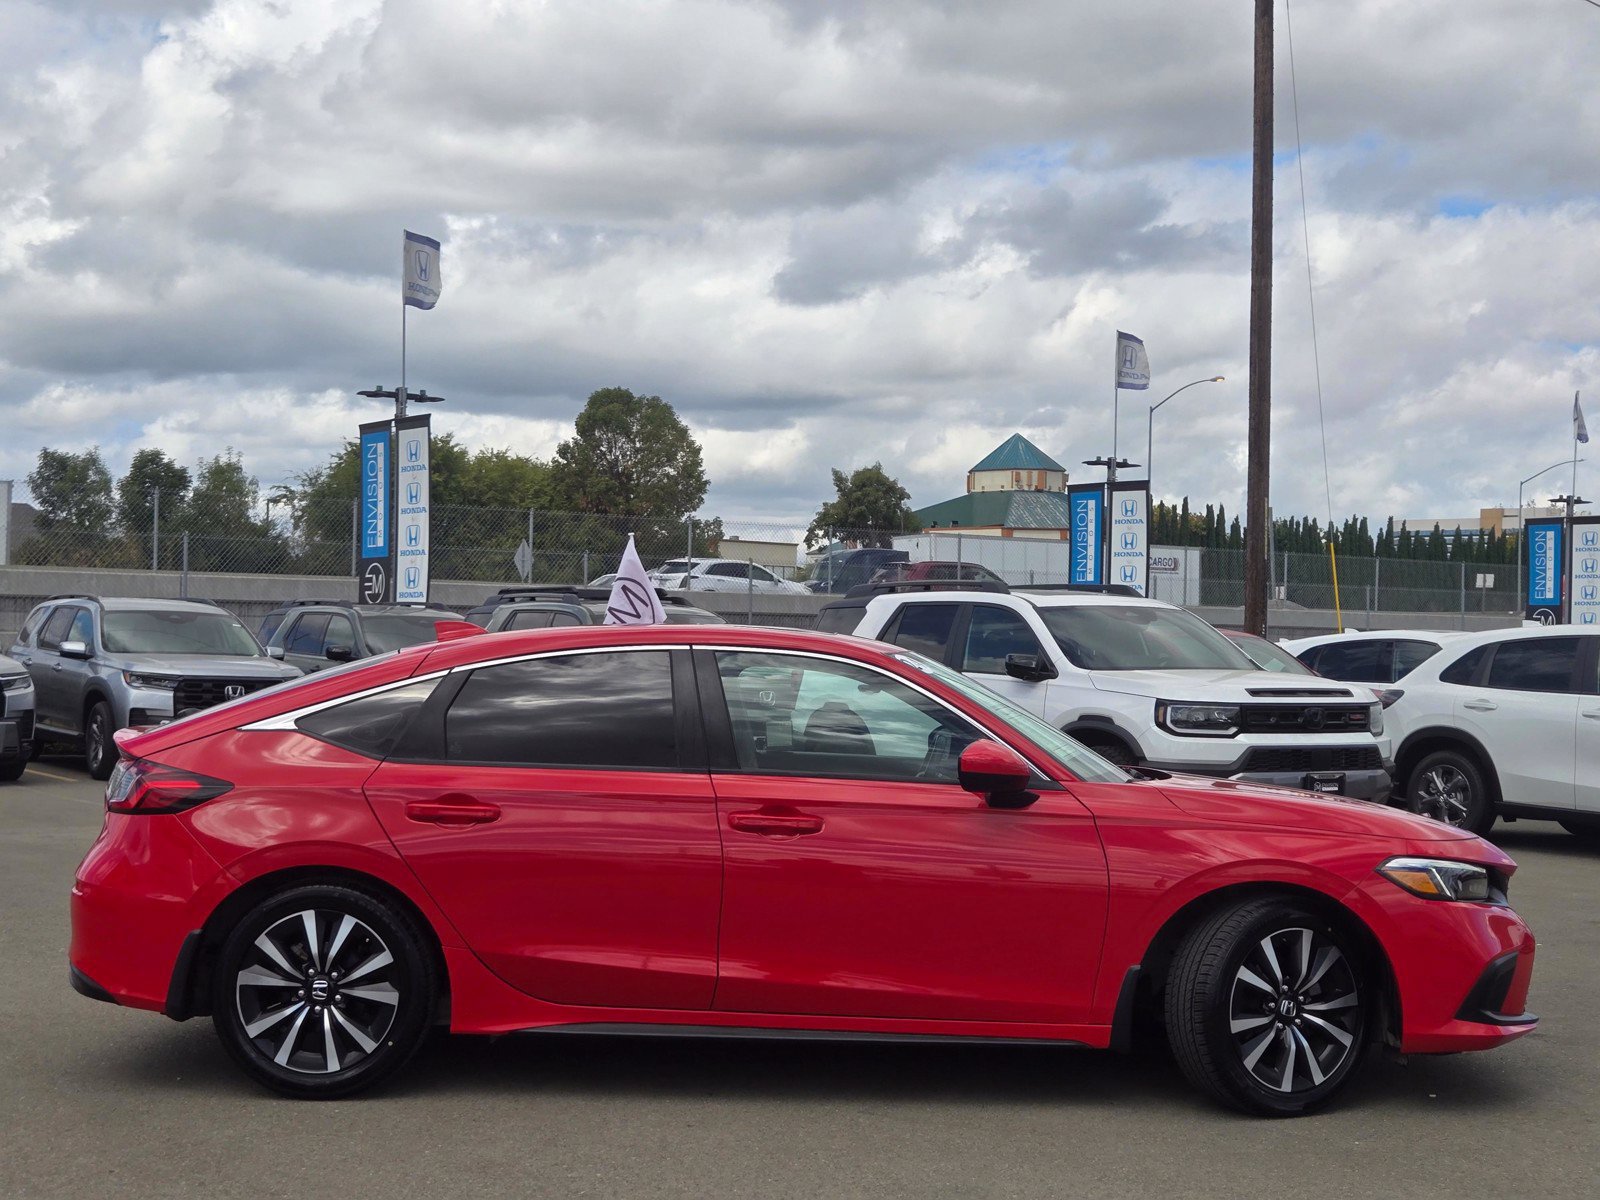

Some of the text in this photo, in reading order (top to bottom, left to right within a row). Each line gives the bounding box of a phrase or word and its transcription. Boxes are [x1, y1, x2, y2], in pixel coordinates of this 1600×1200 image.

[401, 464, 427, 473] HONDA
[367, 442, 378, 548] ENVISION
[400, 549, 427, 557] HONDA
[1076, 500, 1088, 582] ENVISION
[1535, 531, 1546, 599] ENVISION
[399, 591, 424, 599] HONDA
